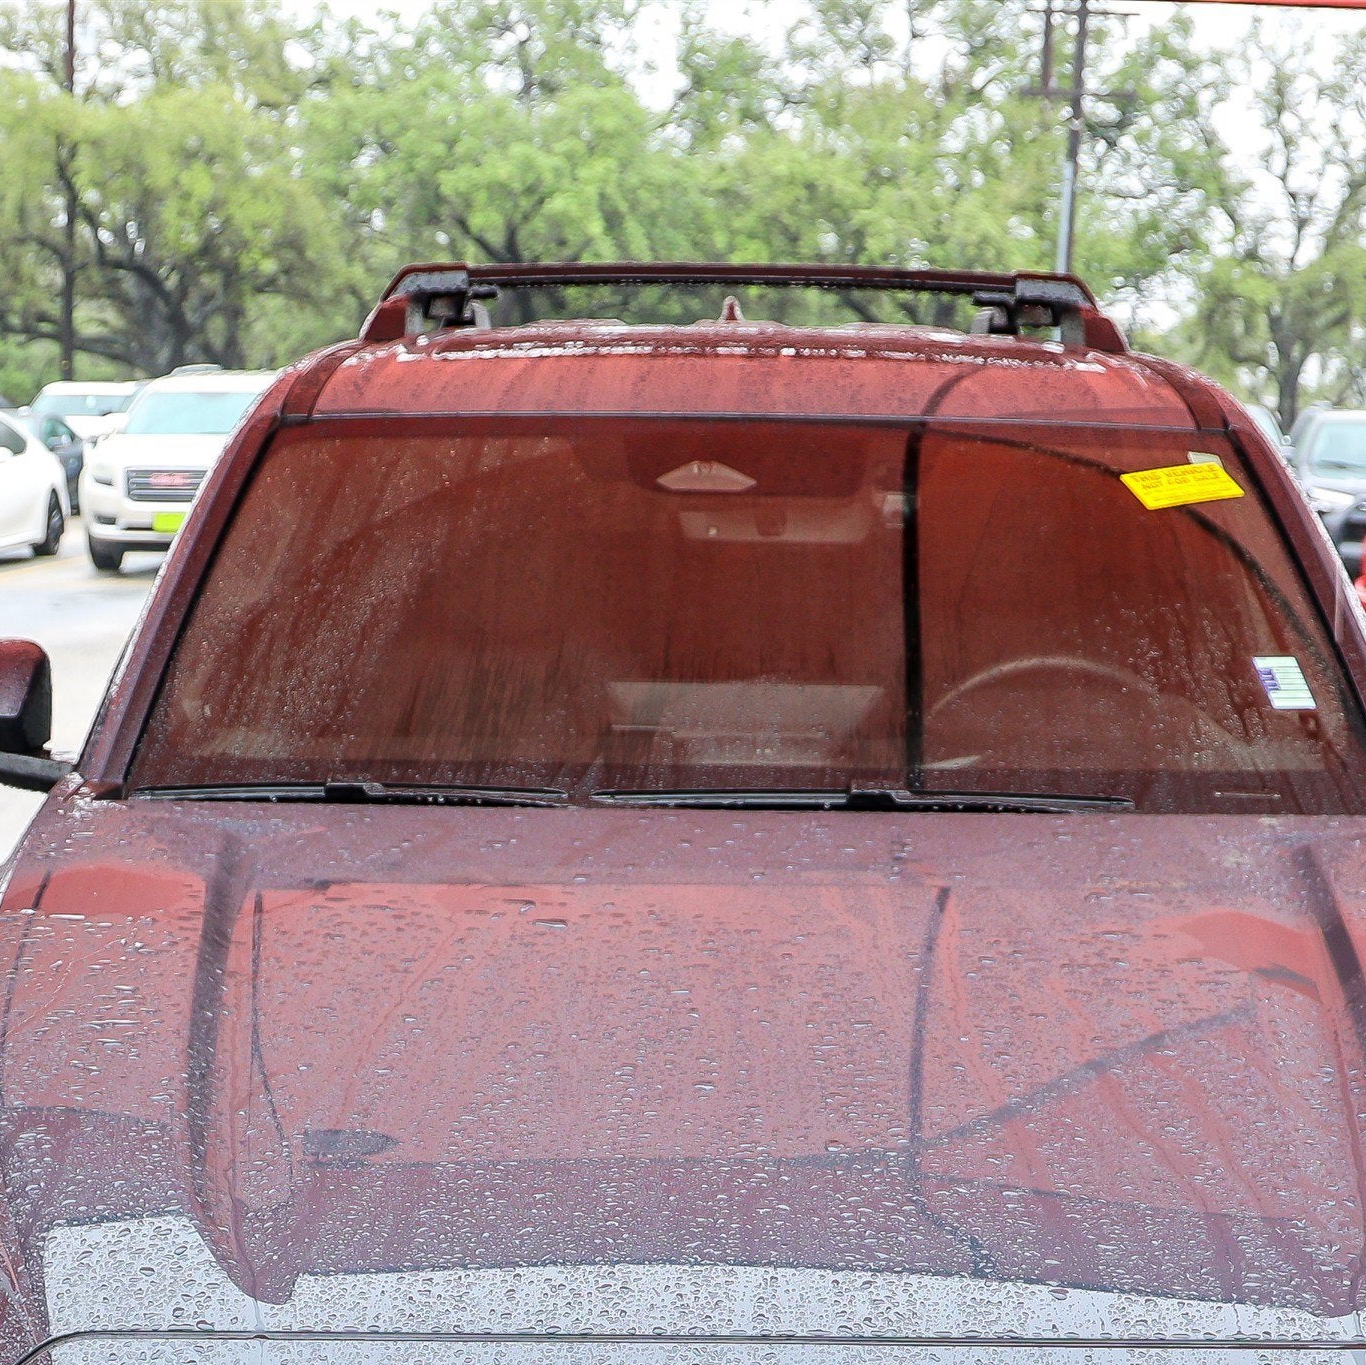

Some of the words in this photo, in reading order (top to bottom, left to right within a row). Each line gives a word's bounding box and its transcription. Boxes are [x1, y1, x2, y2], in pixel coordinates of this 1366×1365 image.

[1129, 471, 1161, 483] THIS
[1163, 464, 1217, 478] VEHICLE
[1141, 480, 1164, 490] NOT
[1167, 476, 1191, 485] FOR
[1192, 472, 1220, 482] SALE
